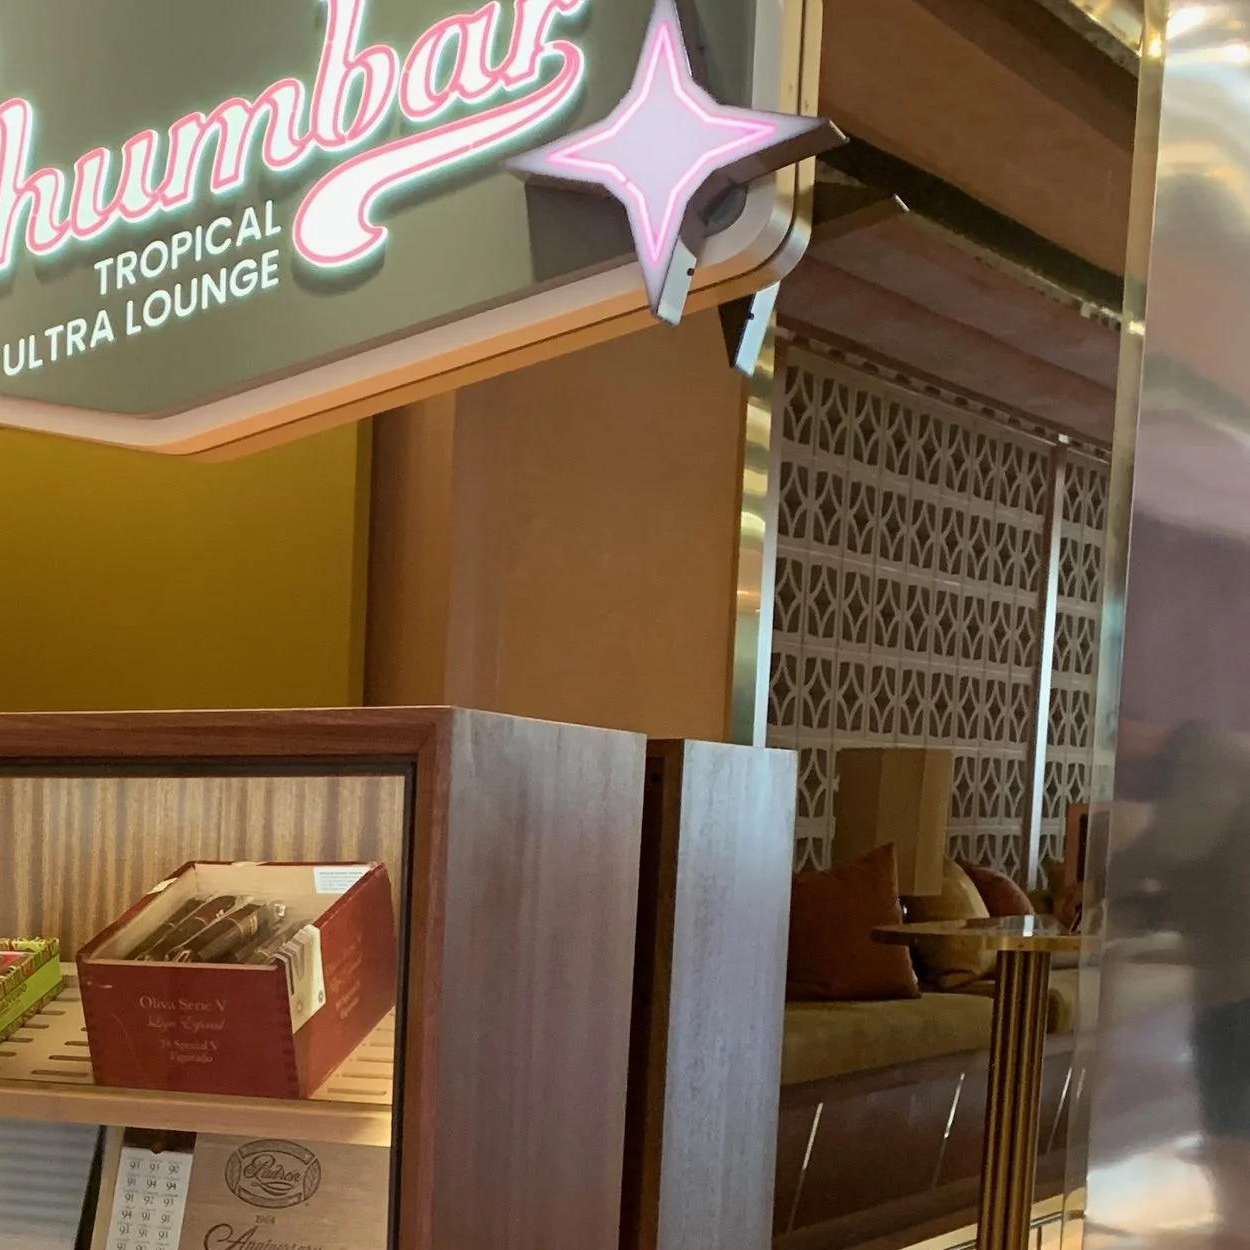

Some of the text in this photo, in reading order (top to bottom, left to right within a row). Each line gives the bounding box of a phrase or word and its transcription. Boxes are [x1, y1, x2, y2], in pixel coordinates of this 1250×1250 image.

[93, 200, 282, 295] TROPICAL
[2, 249, 280, 377] ULTRA LOUNGE
[139, 995, 176, 1010] Oliva
